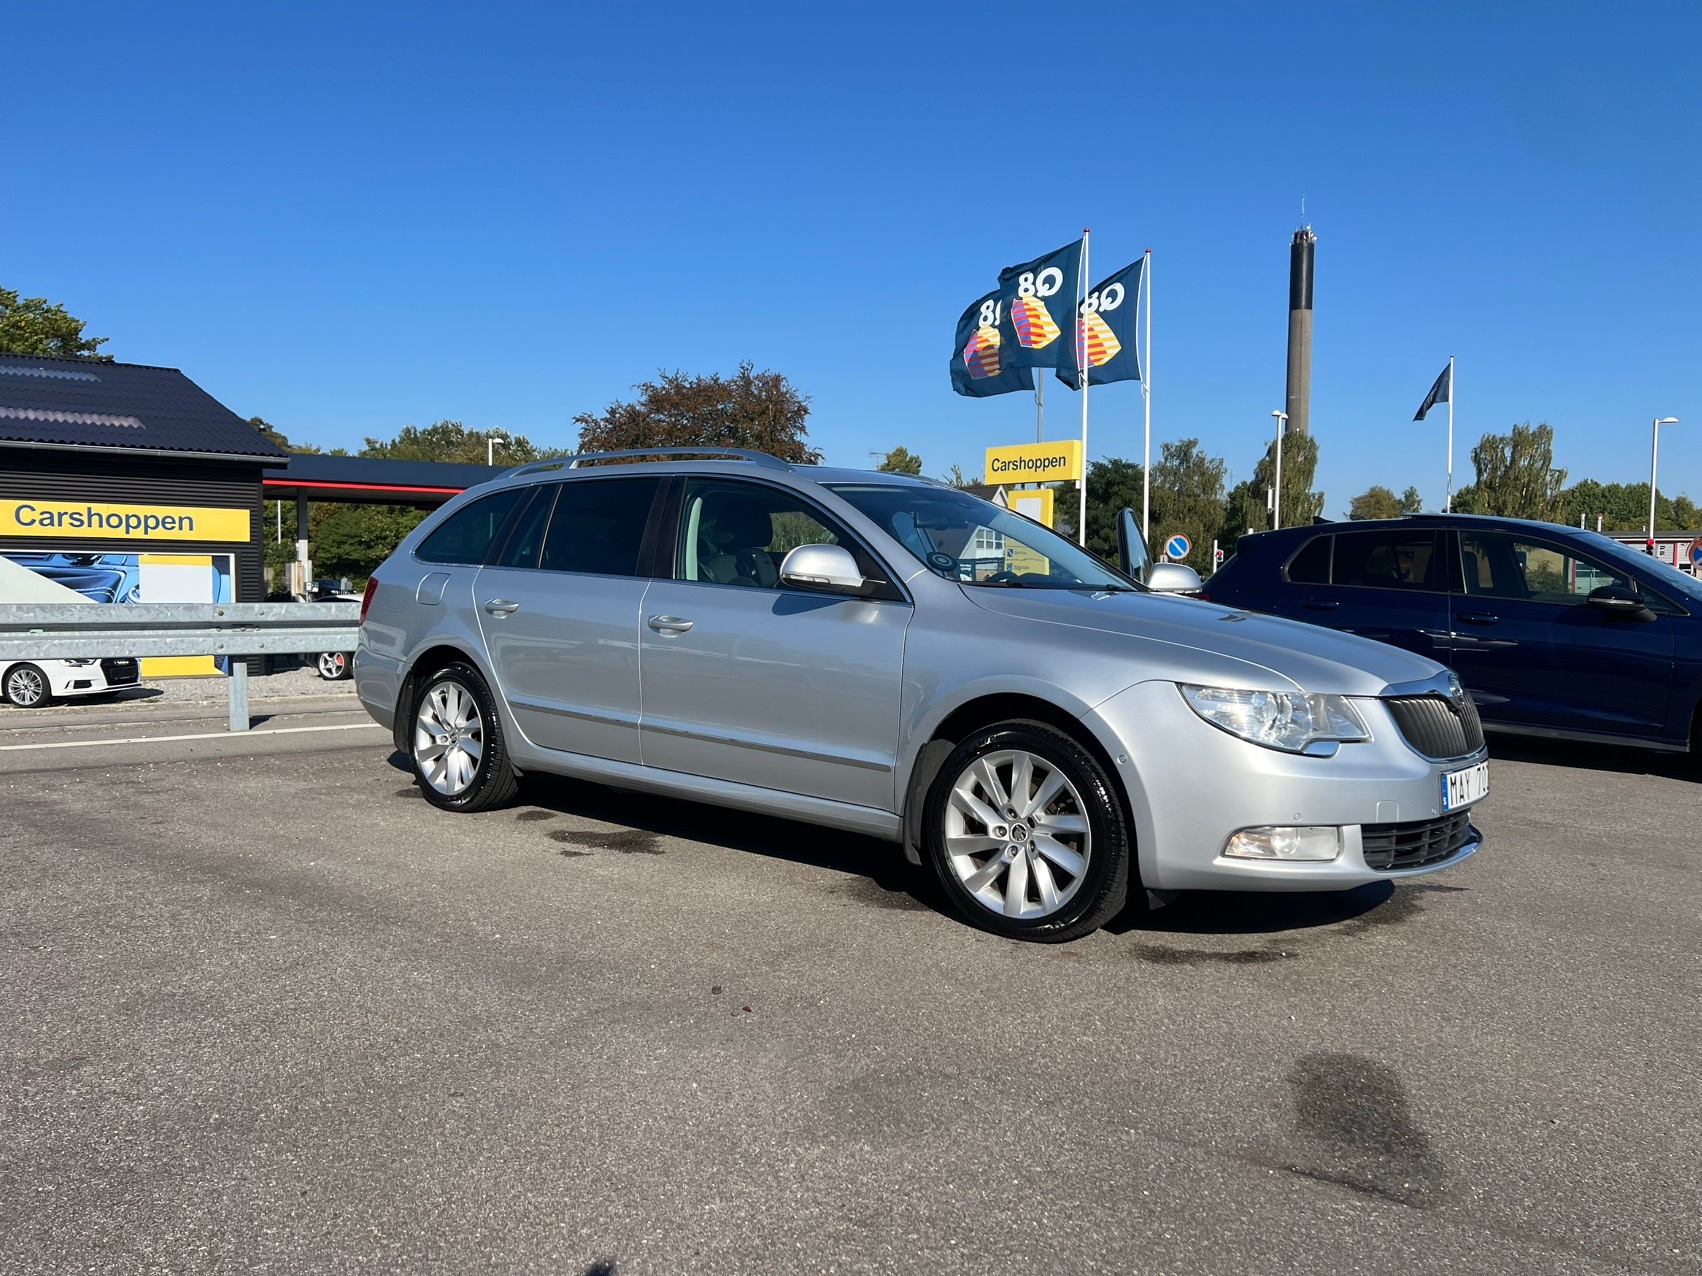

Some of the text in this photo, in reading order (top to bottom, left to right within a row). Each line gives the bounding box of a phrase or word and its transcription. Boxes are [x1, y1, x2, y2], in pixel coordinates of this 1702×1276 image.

[991, 456, 1067, 472] Carshoppen
[14, 504, 194, 535] Carshoppen
[1450, 771, 1470, 806] MAY
[1443, 796, 1448, 806] S
